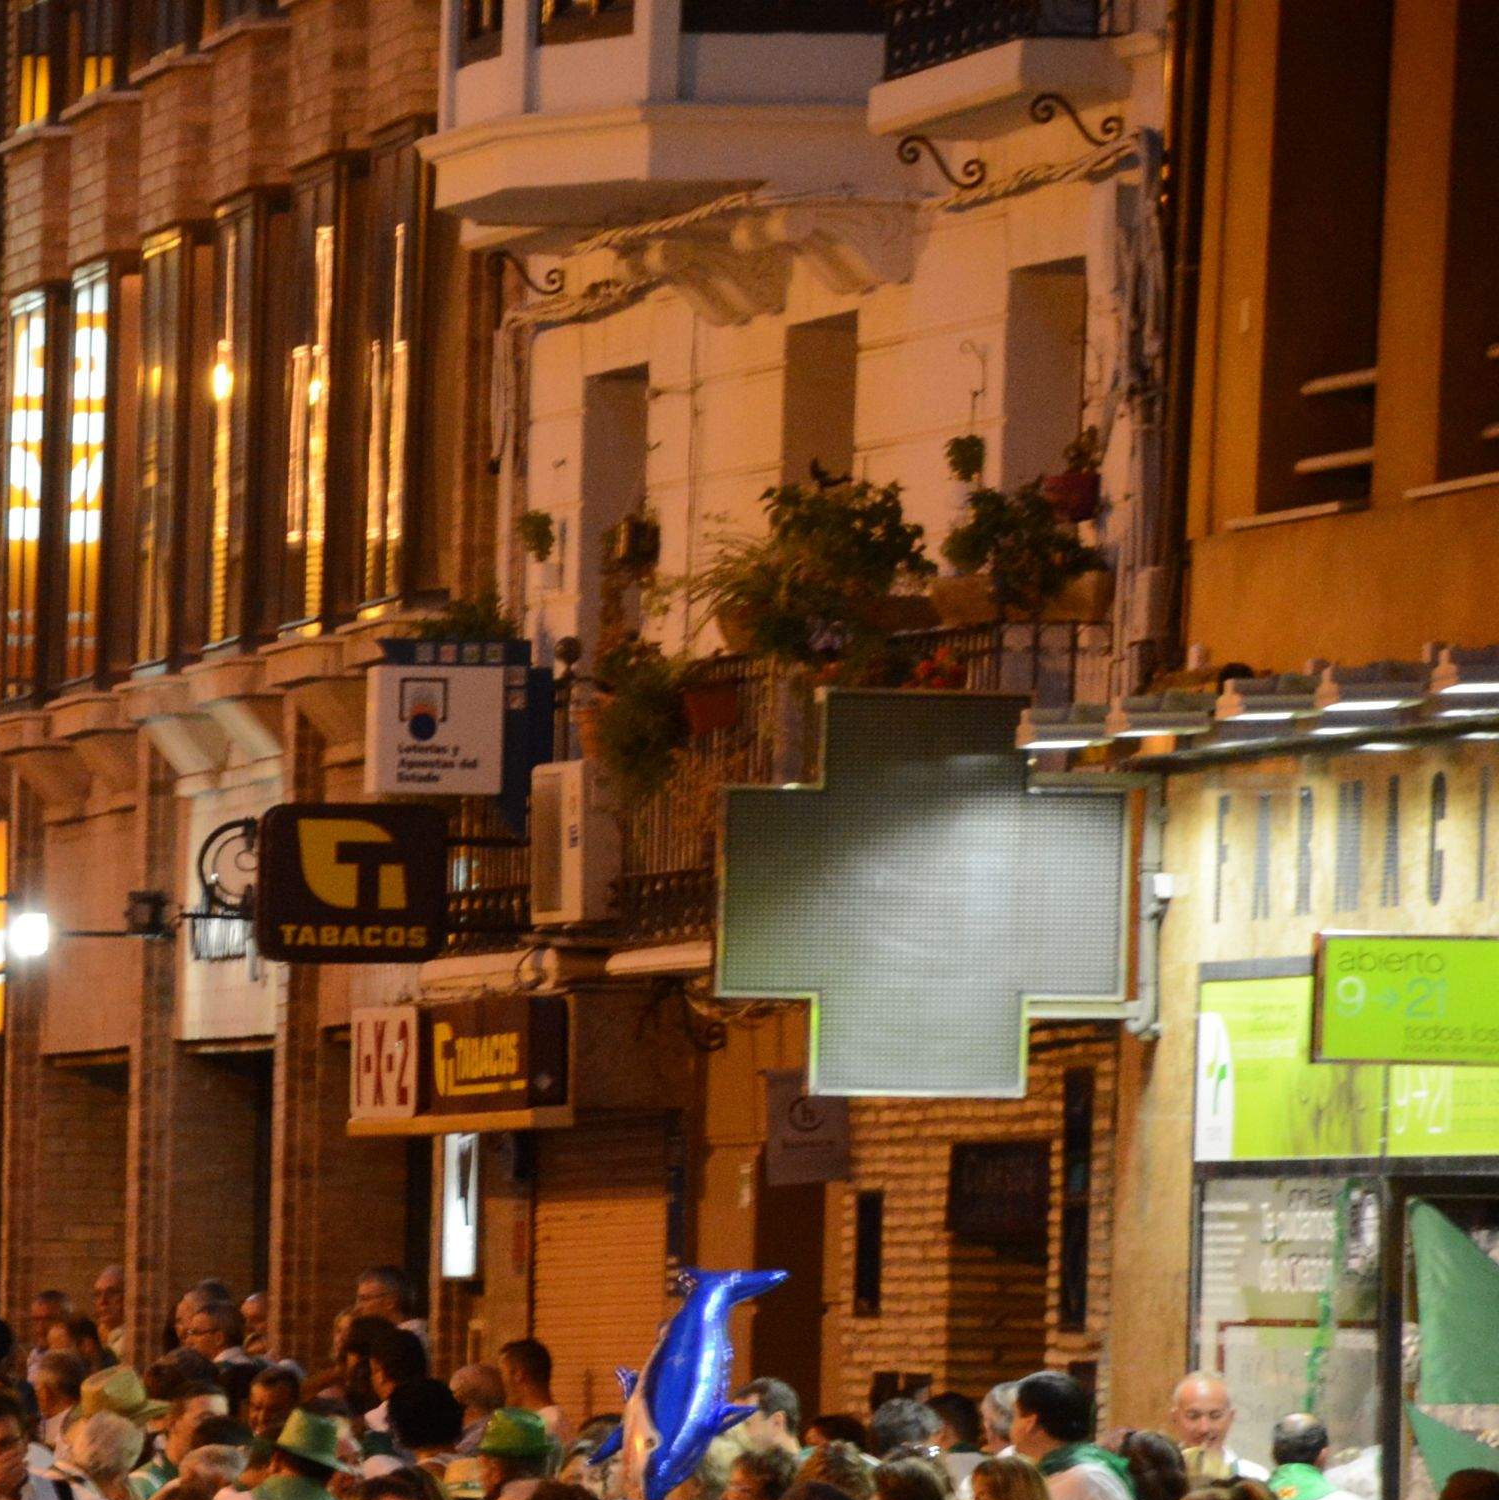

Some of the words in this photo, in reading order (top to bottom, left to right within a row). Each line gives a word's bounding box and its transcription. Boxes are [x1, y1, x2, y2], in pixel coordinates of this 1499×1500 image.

[279, 923, 427, 949] TABACOS
[1337, 945, 1445, 974] abierto
[456, 1032, 519, 1080] TABACOS
